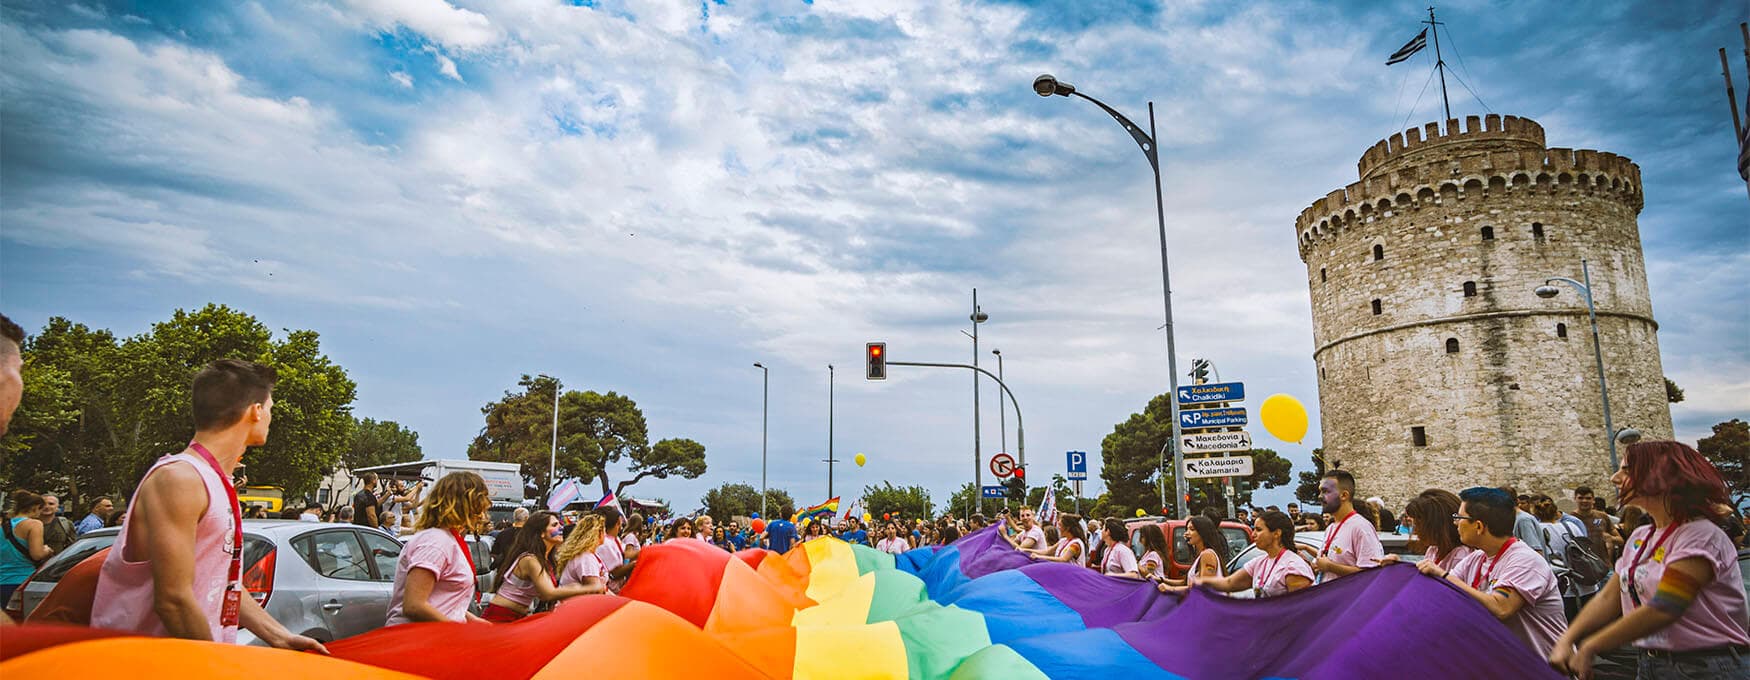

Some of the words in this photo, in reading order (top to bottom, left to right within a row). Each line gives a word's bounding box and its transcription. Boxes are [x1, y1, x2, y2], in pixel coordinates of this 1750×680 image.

[1193, 412, 1202, 424] P
[1196, 434, 1238, 442] Μακεδονία
[1072, 454, 1082, 471] P
[1198, 458, 1244, 467] Καλαμαριά
[1199, 467, 1239, 475] Kalamaria
